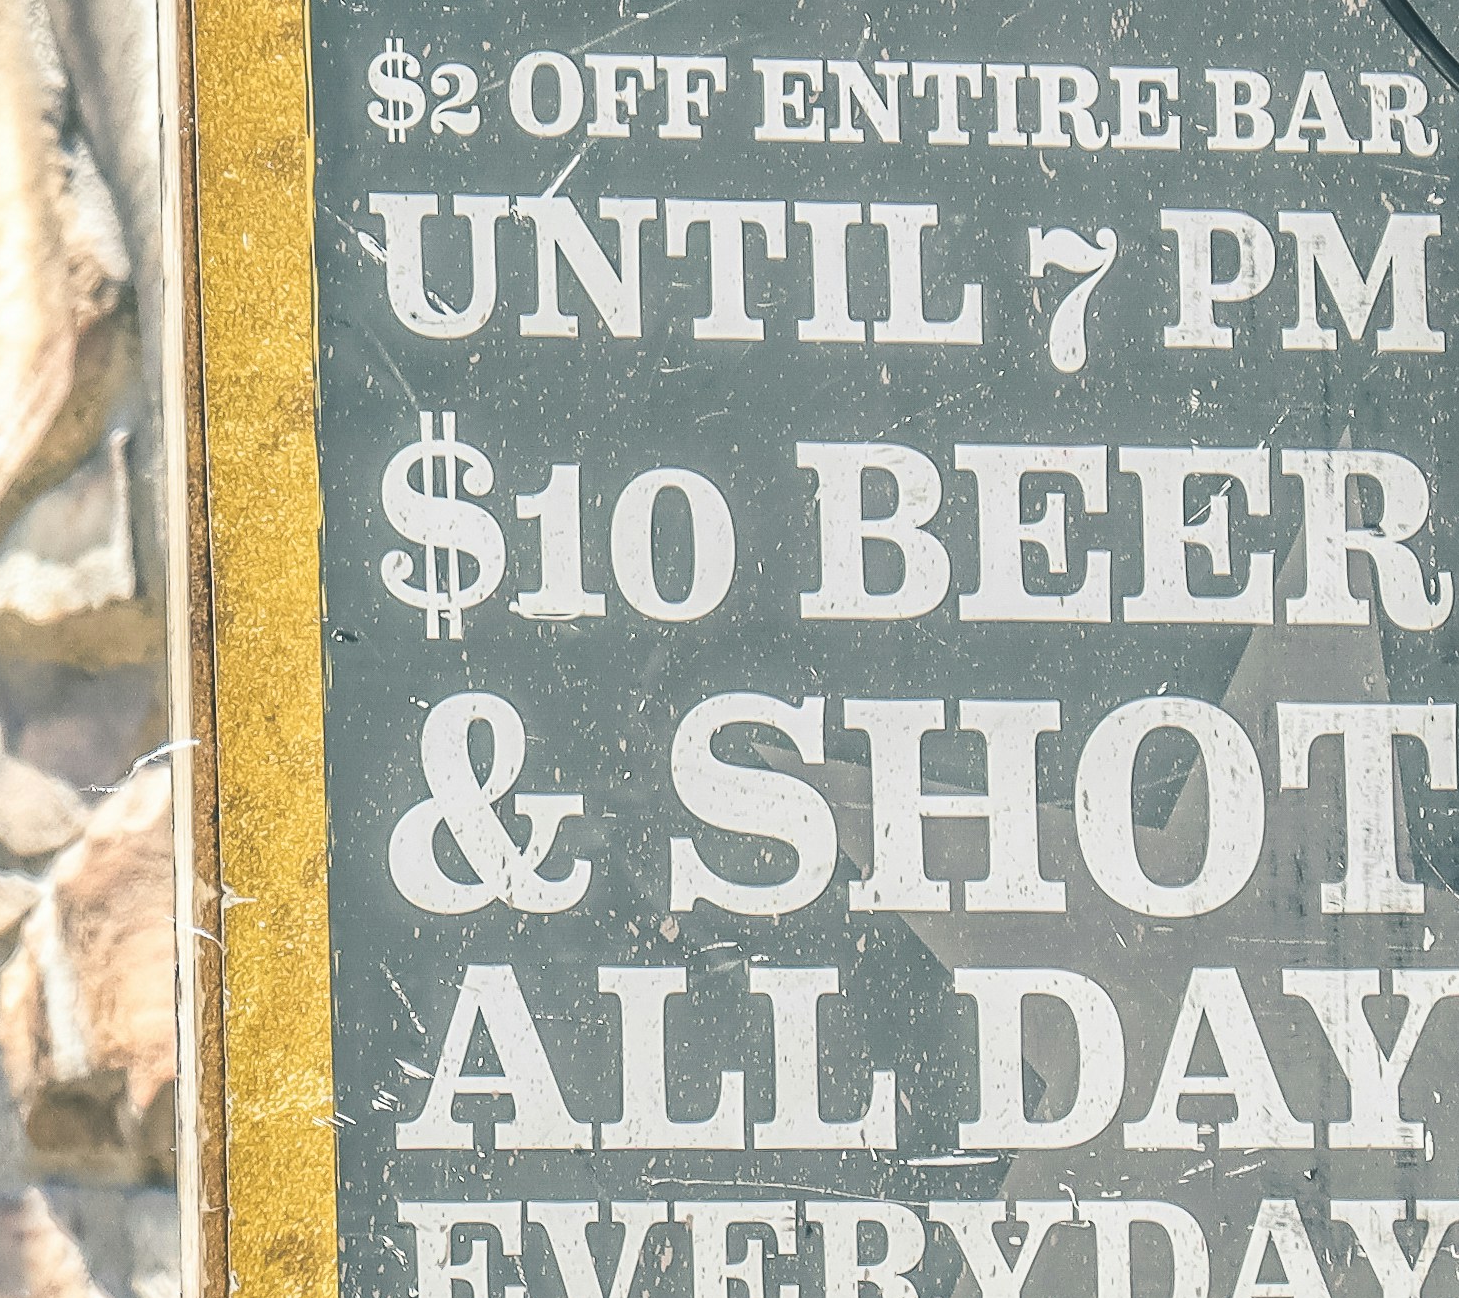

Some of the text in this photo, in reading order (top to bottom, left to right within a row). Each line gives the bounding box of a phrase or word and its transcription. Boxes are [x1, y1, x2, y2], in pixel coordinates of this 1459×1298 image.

[367, 37, 1440, 158] $2 OFF ENTIRE BAR
[367, 191, 1447, 373] UNTIL 7 PM
[379, 410, 1455, 641] $10 BEER
[387, 691, 1459, 918] & SHOT
[393, 963, 899, 1152] ALL
